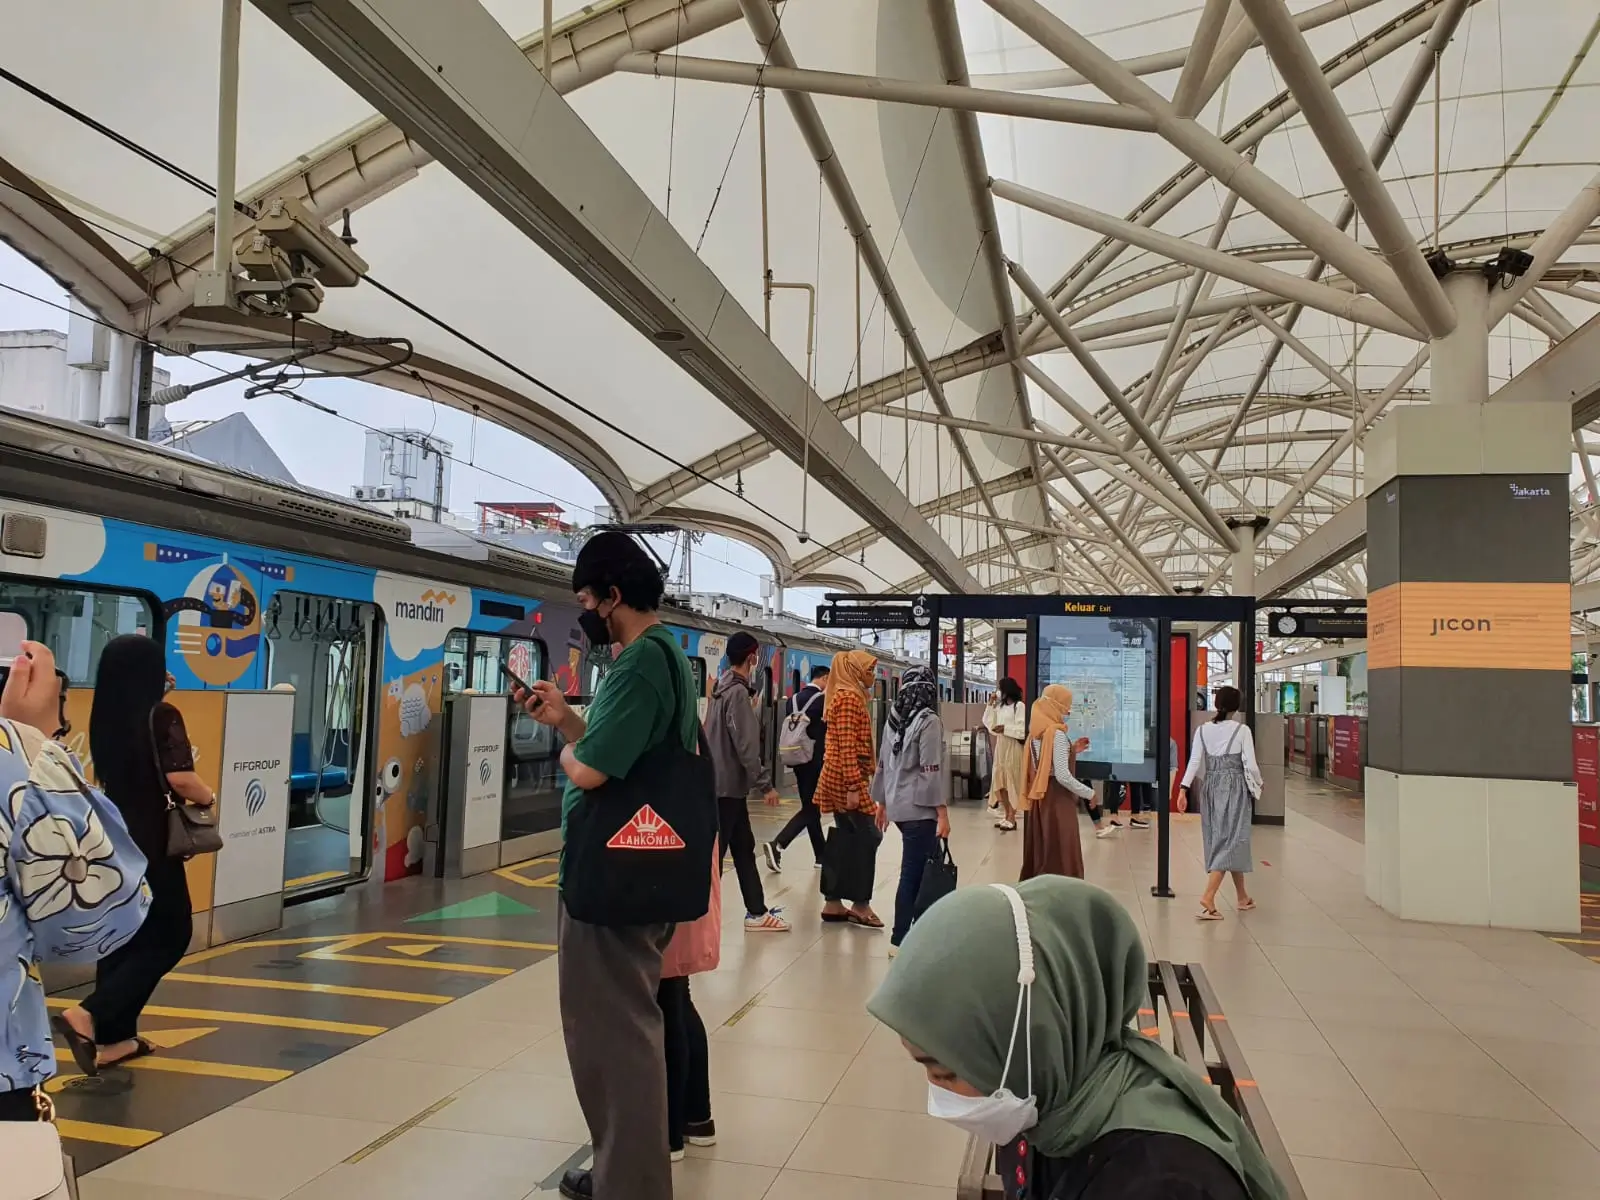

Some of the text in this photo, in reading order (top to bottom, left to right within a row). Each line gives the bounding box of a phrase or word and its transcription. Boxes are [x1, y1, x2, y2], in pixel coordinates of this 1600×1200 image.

[395, 600, 444, 623] mandiri
[1064, 602, 1096, 612] Keluar
[821, 609, 831, 624] 4
[233, 759, 281, 773] FIFGROUP
[258, 825, 277, 834] ASTRA
